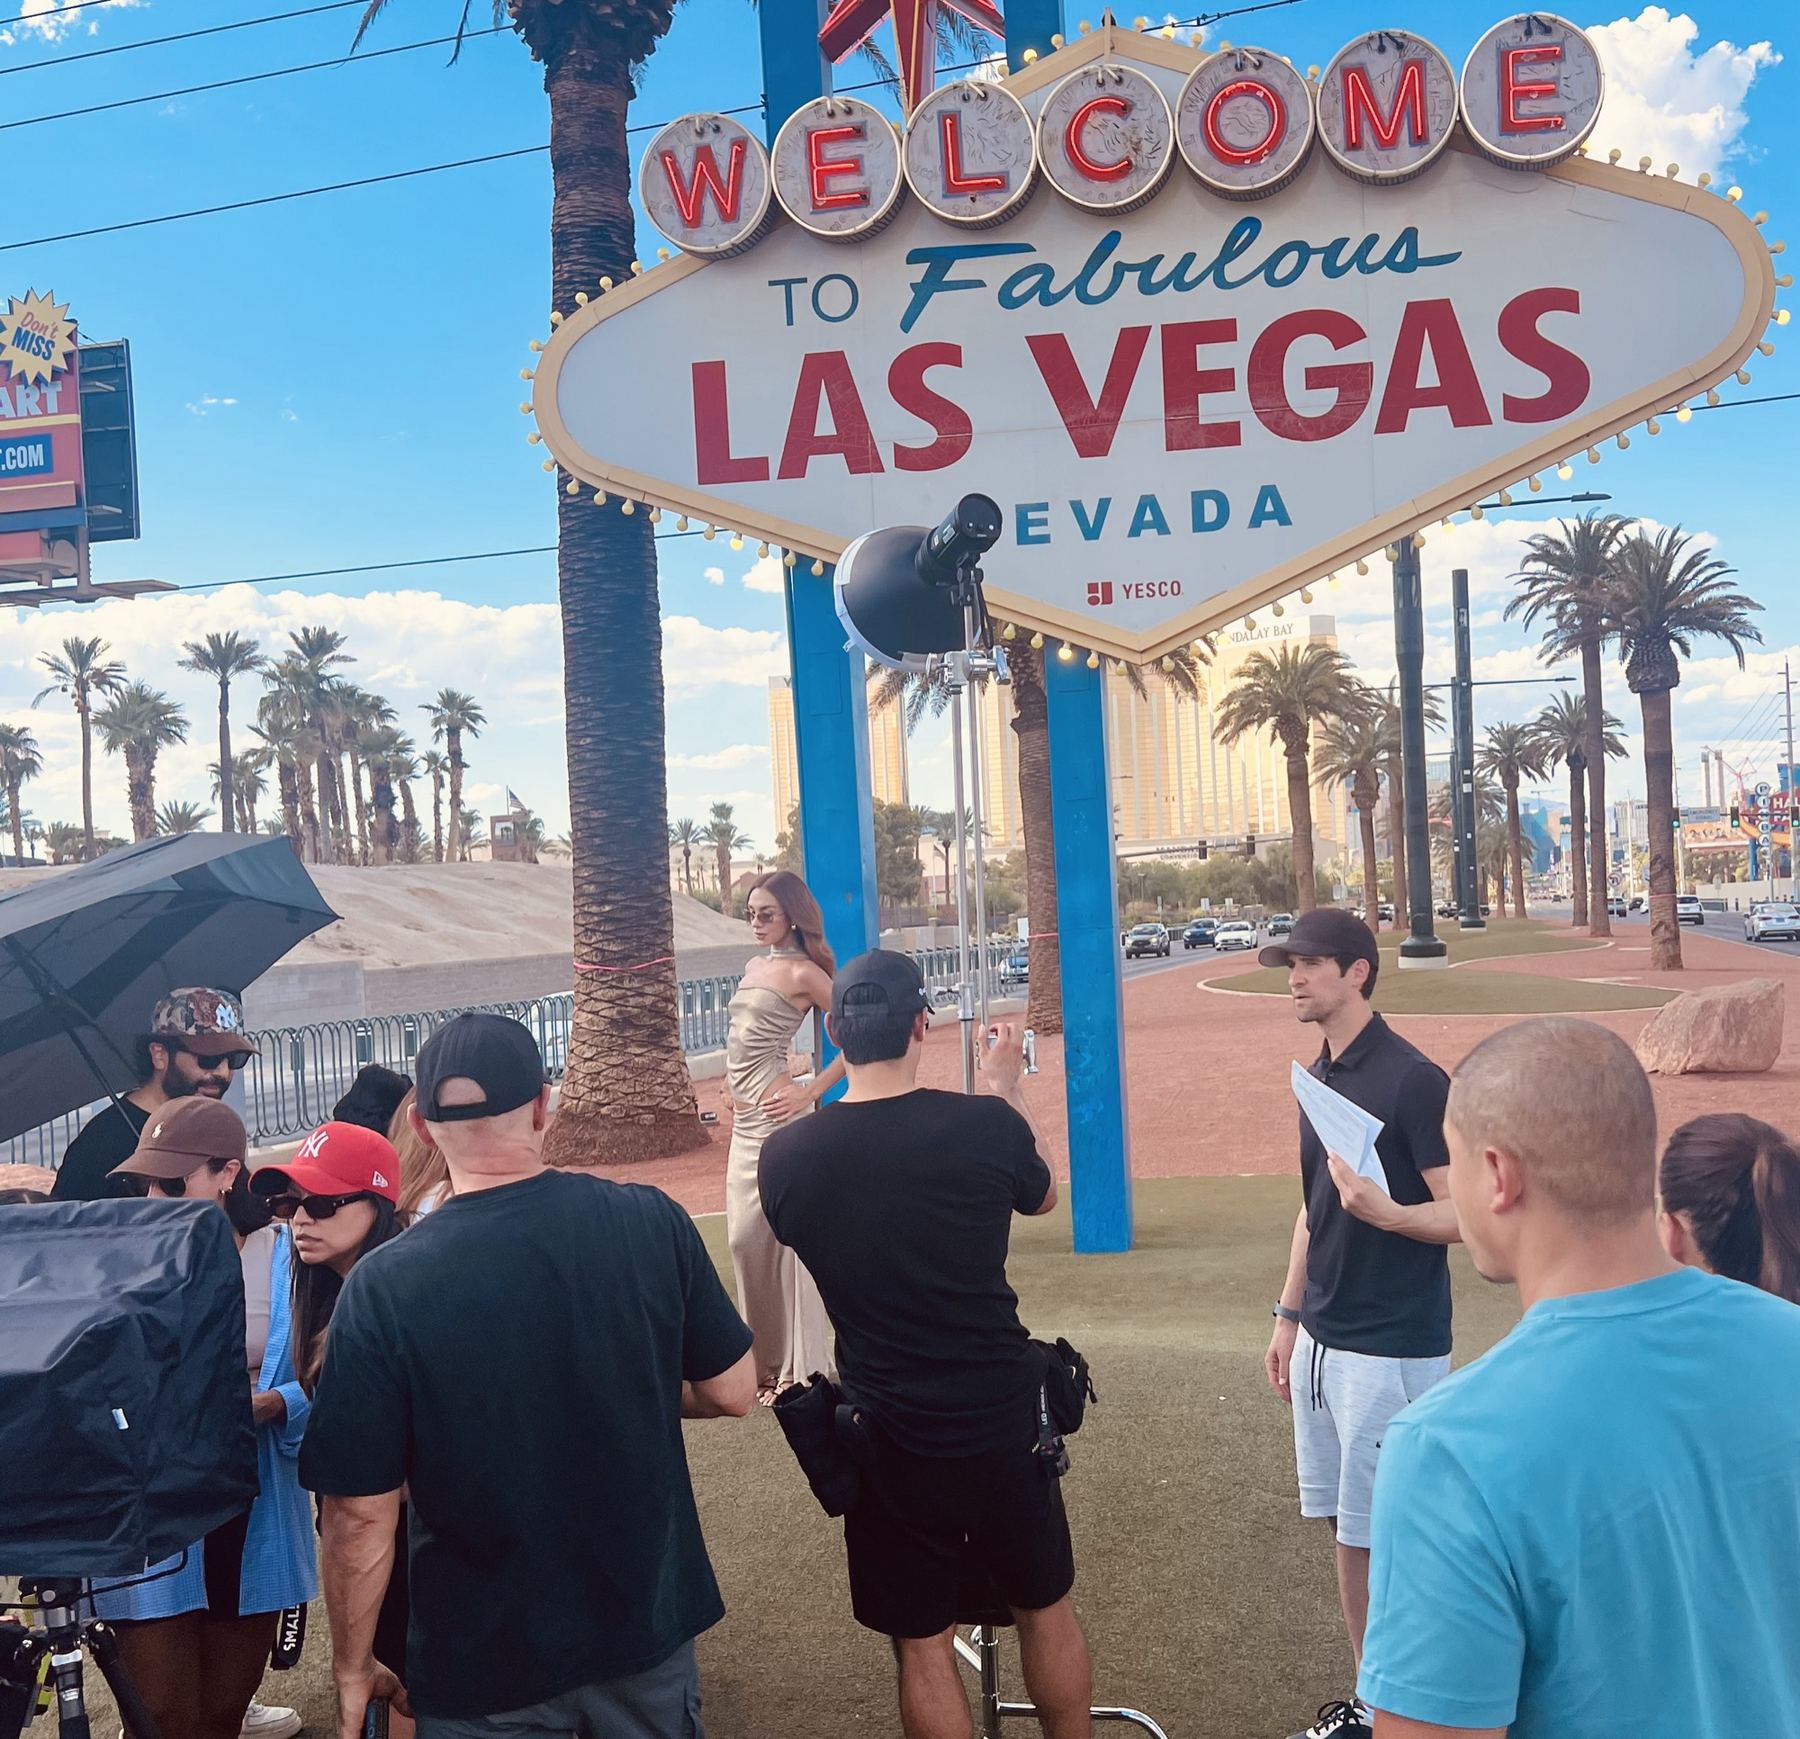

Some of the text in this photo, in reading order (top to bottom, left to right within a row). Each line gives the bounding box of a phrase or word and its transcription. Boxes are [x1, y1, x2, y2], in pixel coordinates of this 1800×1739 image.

[659, 45, 1567, 230] WELCOME
[767, 216, 1463, 334] TO Fabulous
[20, 311, 59, 340] Don't
[11, 326, 56, 361] MISS
[691, 287, 1591, 486] LAS VEGAS
[0, 443, 44, 471] .COM
[1014, 483, 1293, 546] EVADA
[1122, 580, 1182, 600] YESCO
[1273, 624, 1294, 637] BAY
[297, 1131, 329, 1158] NY
